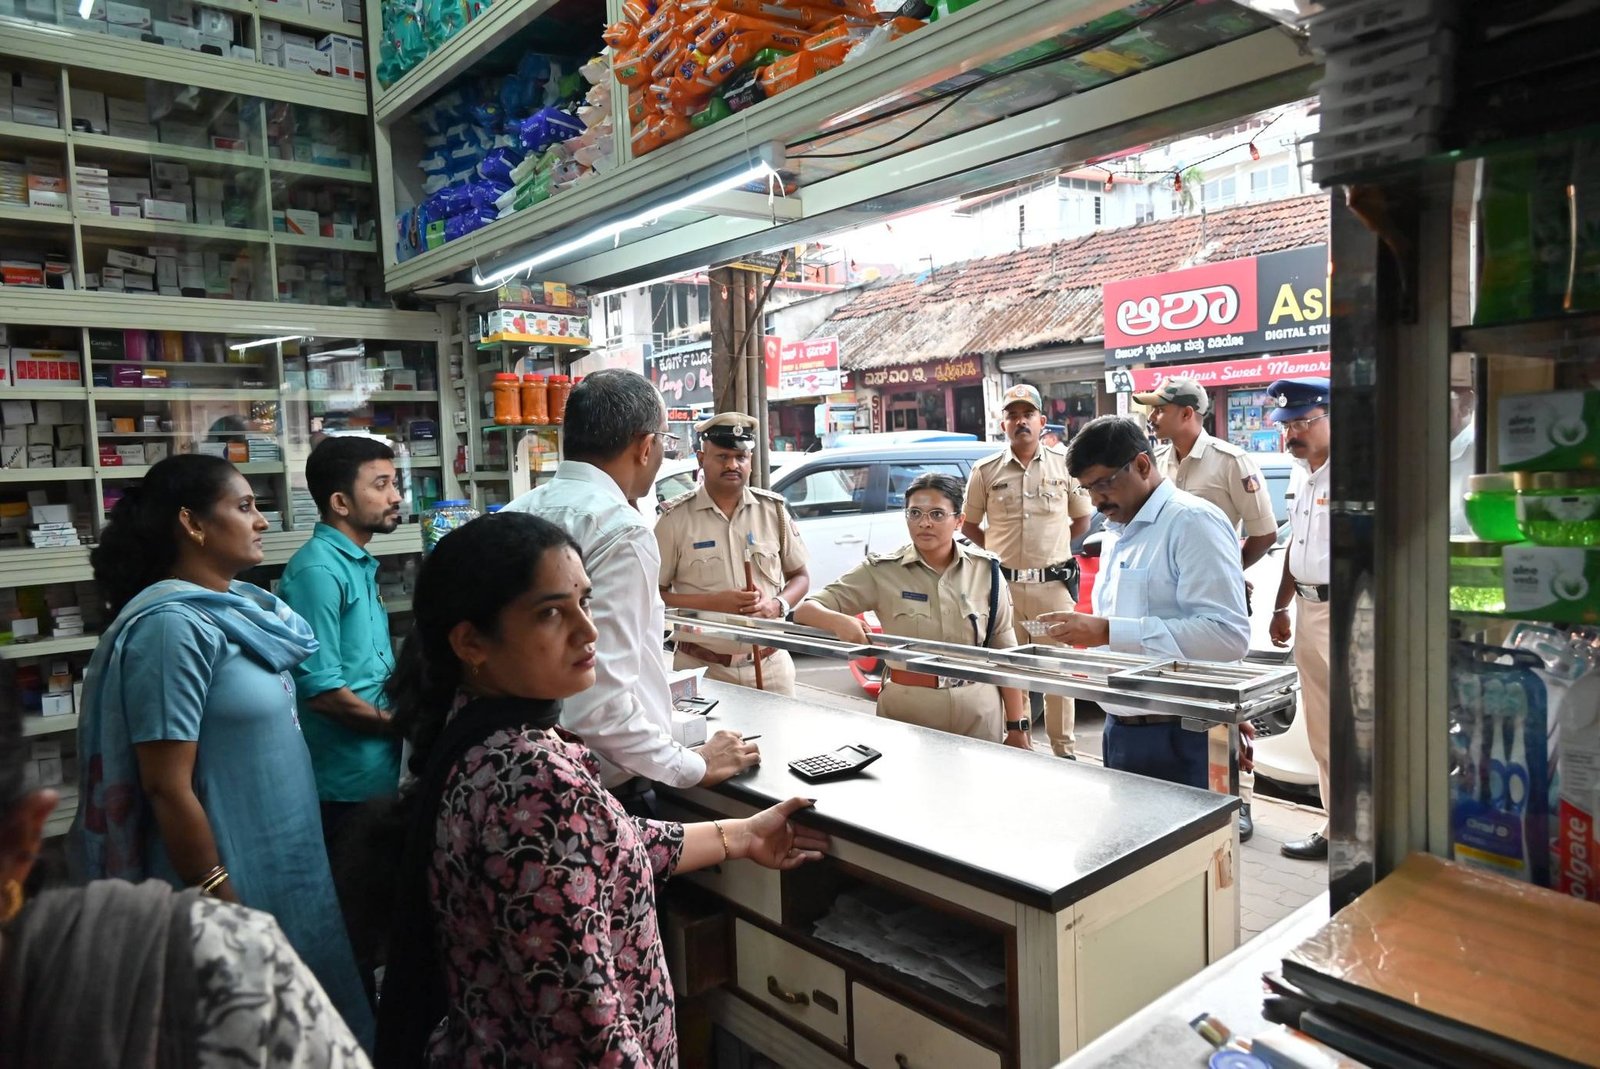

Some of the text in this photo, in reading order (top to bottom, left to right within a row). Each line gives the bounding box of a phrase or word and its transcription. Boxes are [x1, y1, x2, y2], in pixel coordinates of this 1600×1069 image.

[1117, 285, 1239, 335] ಆಶಾ
[1265, 326, 1307, 341] DIGITAL
[1222, 365, 1262, 382] Sweet
